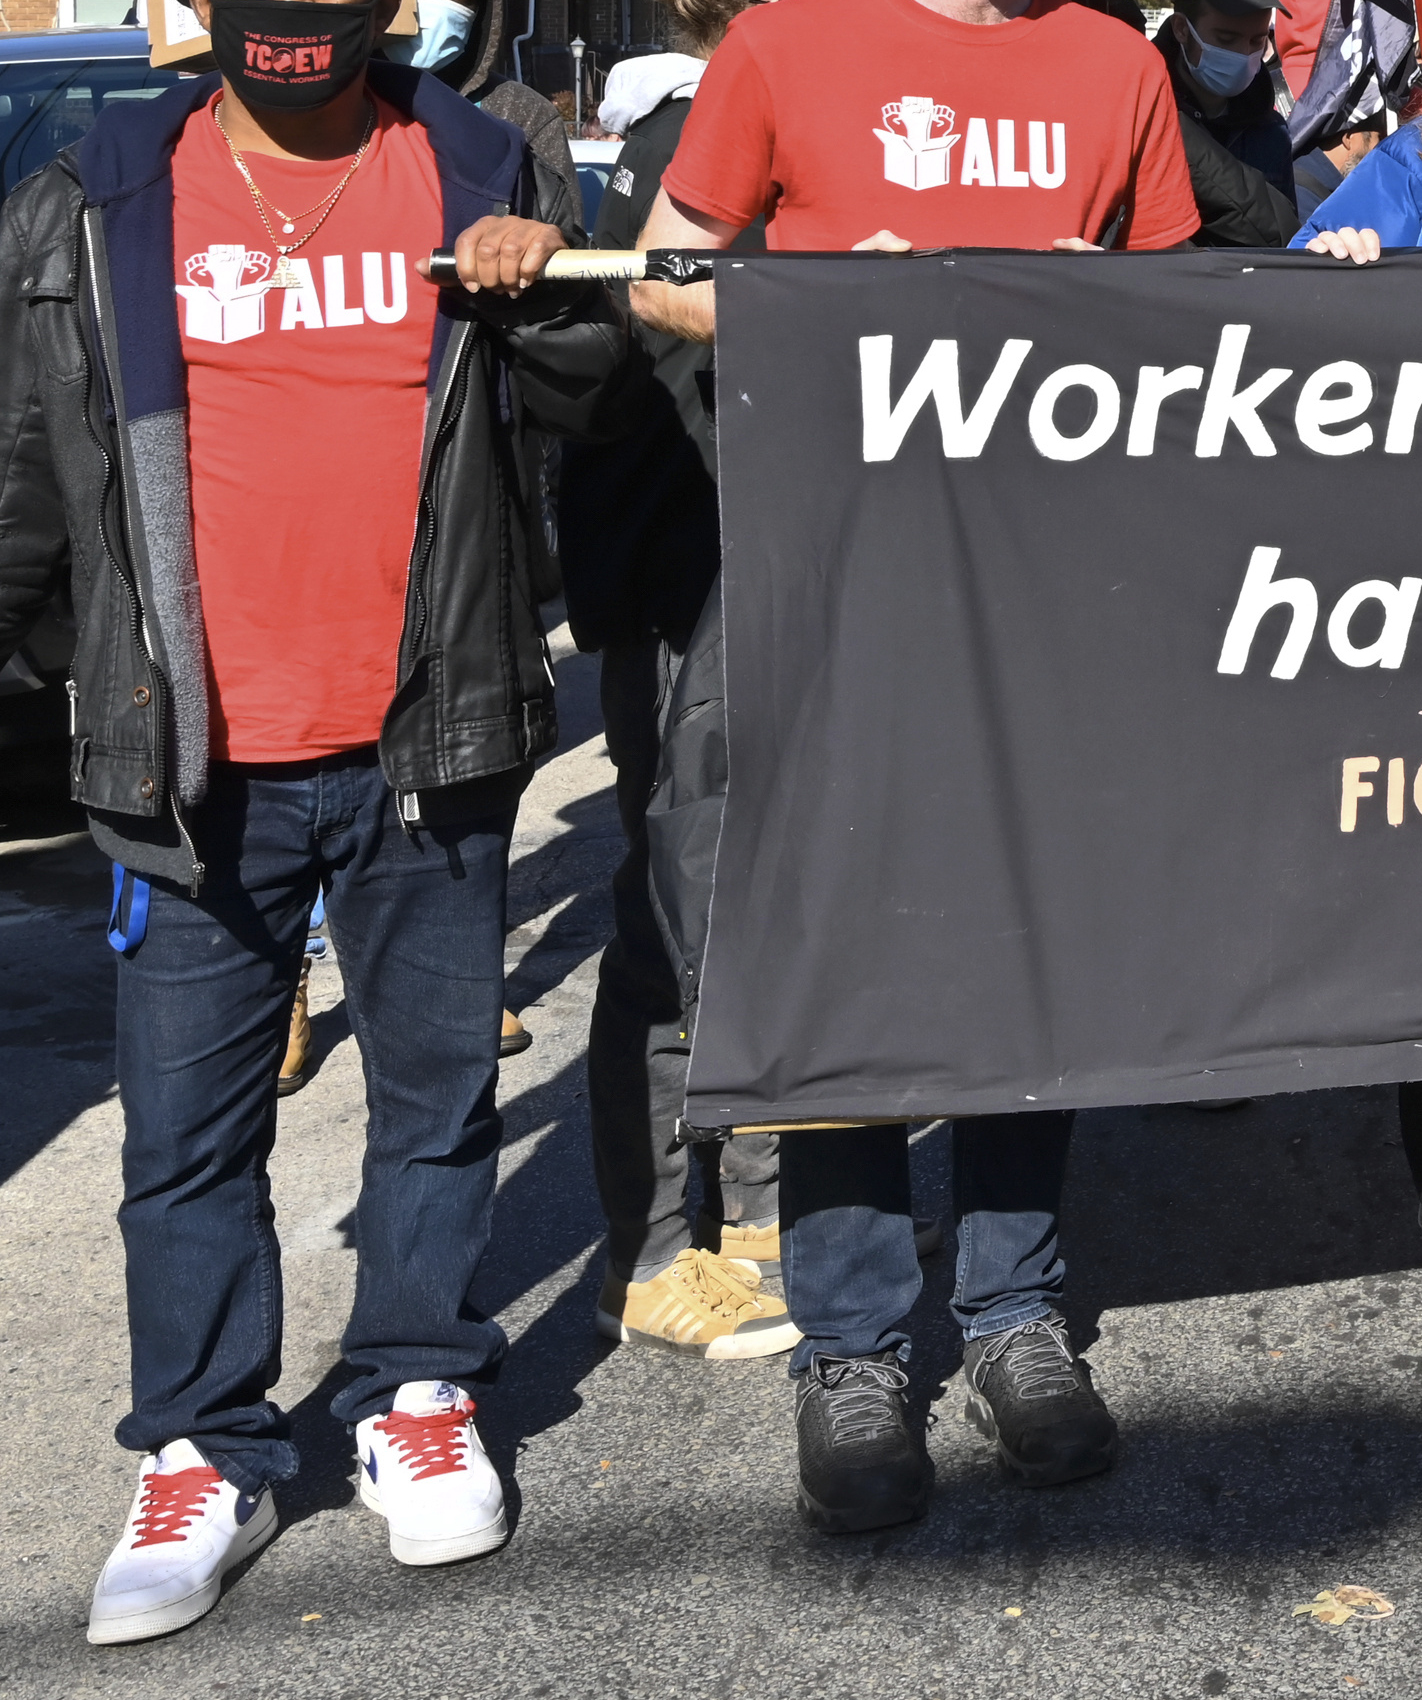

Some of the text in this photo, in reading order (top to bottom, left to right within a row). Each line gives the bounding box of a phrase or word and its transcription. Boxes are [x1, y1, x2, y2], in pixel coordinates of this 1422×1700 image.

[243, 31, 333, 44] THE CONGRESS OF
[243, 69, 331, 84] ESSENTIAL WORKERS
[960, 117, 1067, 189] ALU
[279, 251, 408, 331] ALU
